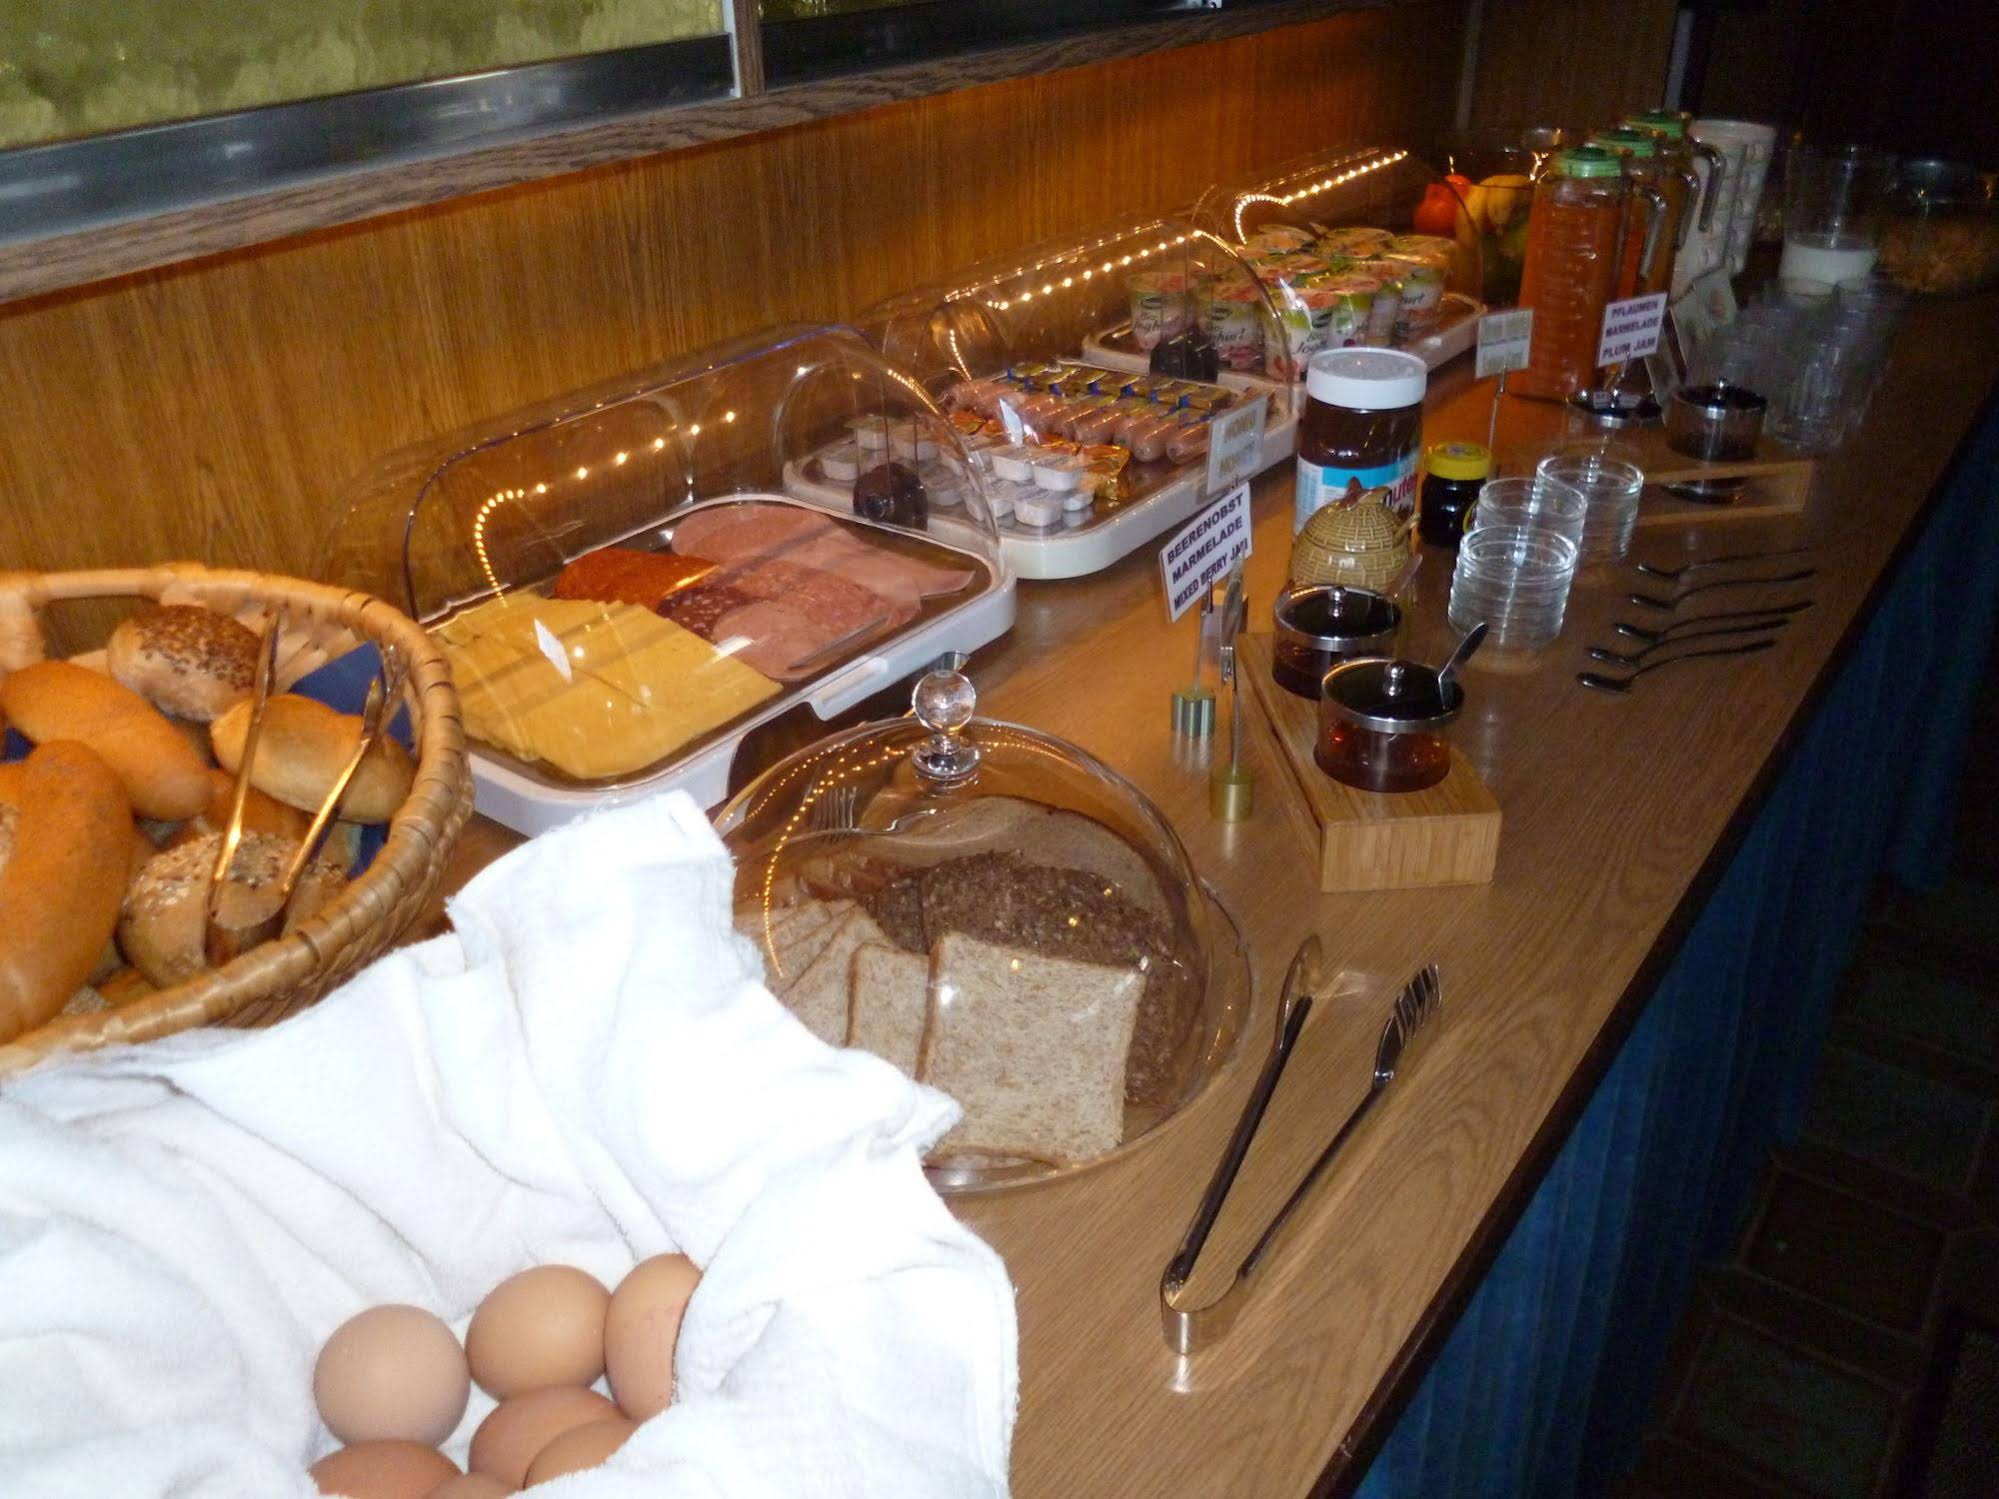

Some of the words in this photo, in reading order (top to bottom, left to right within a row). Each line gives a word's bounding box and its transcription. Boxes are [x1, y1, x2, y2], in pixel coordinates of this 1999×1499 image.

[1602, 344, 1631, 359] PLUM
[1633, 336, 1657, 352] JAM
[1167, 492, 1244, 565] BEERENOBST
[1172, 515, 1243, 584] MARMELADE
[1173, 578, 1199, 611] MIXED
[1200, 555, 1227, 586] BERRY
